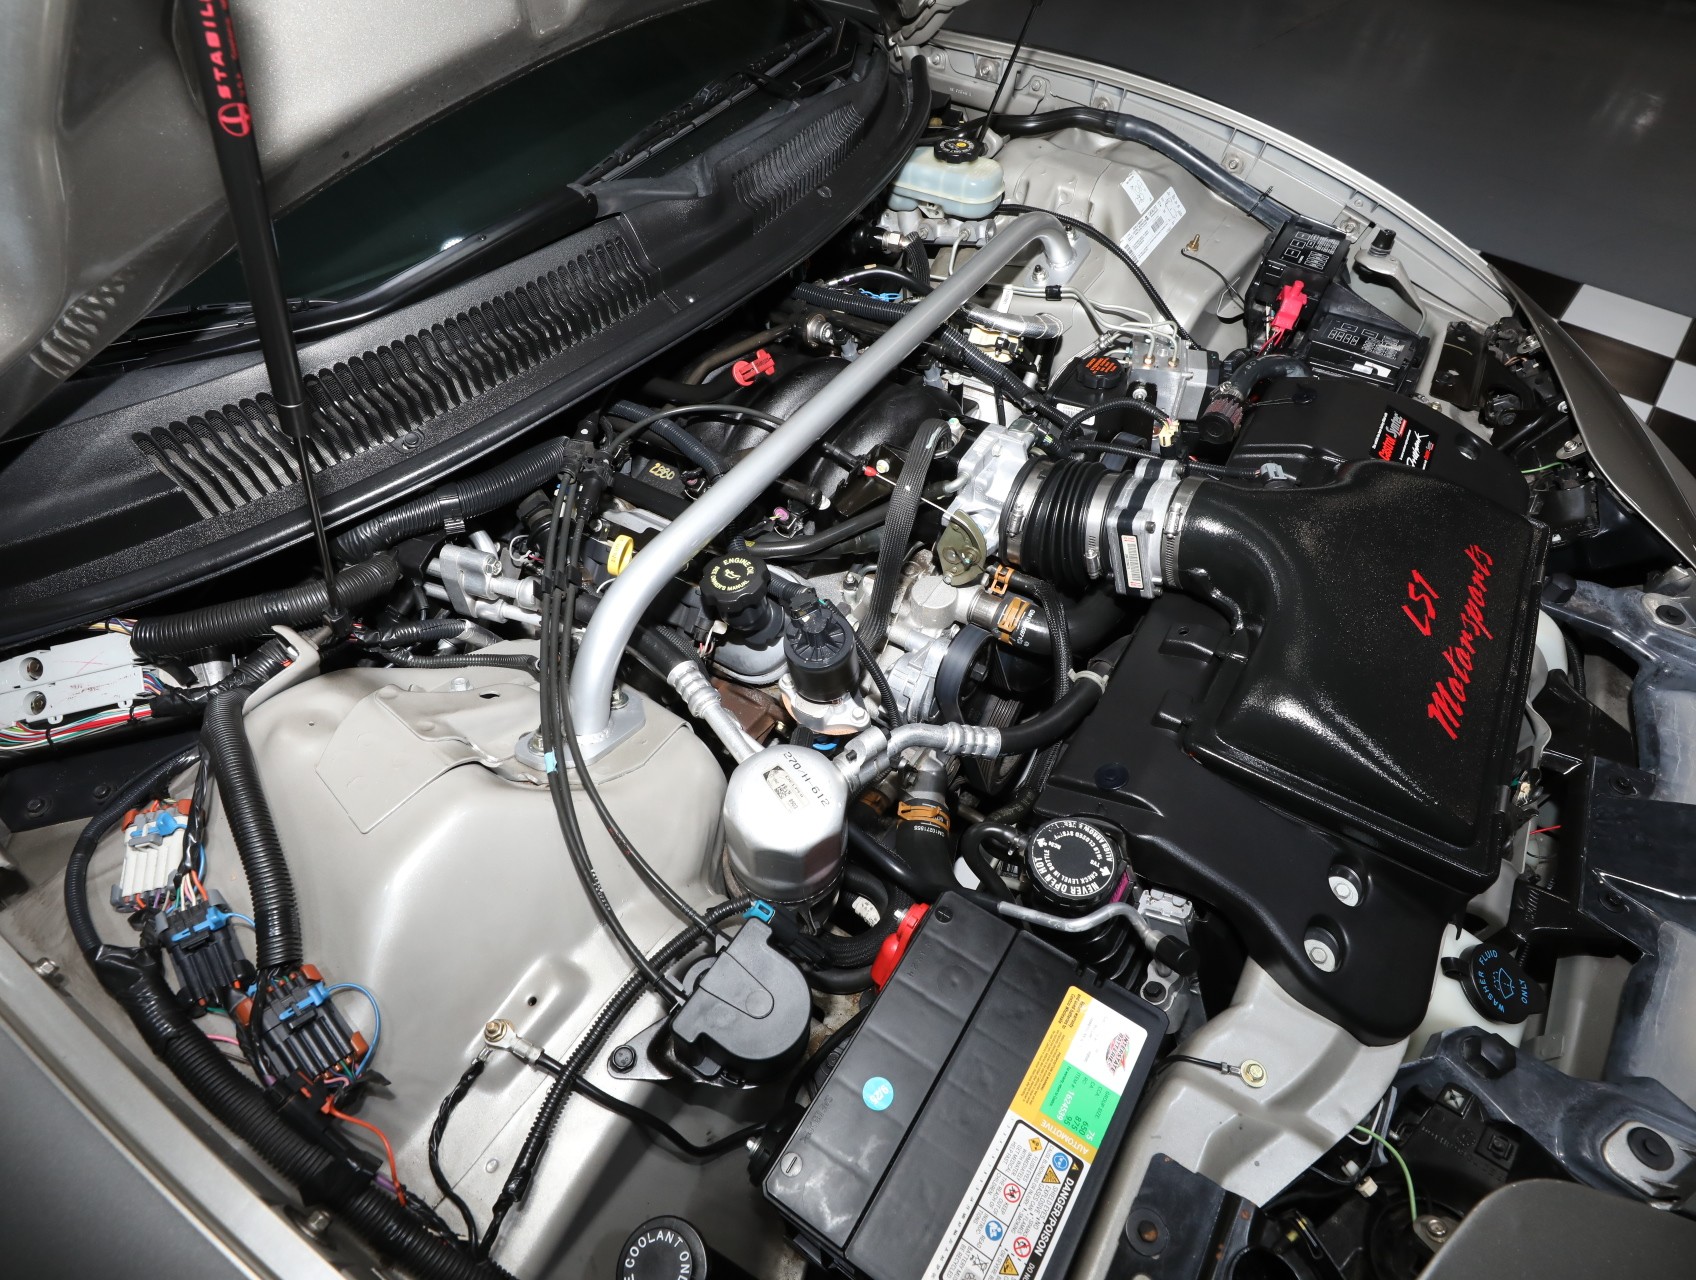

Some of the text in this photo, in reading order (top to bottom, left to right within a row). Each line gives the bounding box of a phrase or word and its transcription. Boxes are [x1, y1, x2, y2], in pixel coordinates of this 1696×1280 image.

[1378, 433, 1396, 462] Castrol
[722, 557, 754, 575] ENGINE OIL
[710, 574, 726, 590] OWNER'S
[726, 579, 749, 590] MANUAL
[1402, 570, 1441, 637] LS1
[1428, 545, 1495, 740] Motorsports
[1075, 831, 1095, 846] CLOSED
[1043, 849, 1054, 870] BOTTLE
[1101, 843, 1112, 861] ALIGN
[1032, 856, 1099, 894] NEVER OPEN HOT
[1061, 874, 1078, 883] LEVEL
[1080, 871, 1098, 884] CHECK
[1479, 949, 1506, 1013] WASHER FLUID
[1520, 978, 1529, 1004] ONLY
[1106, 1032, 1123, 1066] BATTERIES
[1110, 1034, 1130, 1073] INTERSTATE
[1055, 1089, 1075, 1121] 1624539
[1069, 1081, 1095, 1131] CA 875
[1077, 1085, 1102, 1136] CCA 650
[1094, 1107, 1103, 1119] SIZE
[1062, 1114, 1072, 1126] 95
[1040, 1119, 1088, 1155] AUTOMOTIVE
[1084, 1129, 1095, 1141] 75
[1006, 1140, 1016, 1154] HELP
[1017, 1147, 1027, 1161] WITH
[1044, 1144, 1054, 1159] CAUSE
[1004, 1144, 1022, 1174] GET MEDICAL
[1015, 1151, 1032, 1181] IMMEDIATELY
[1022, 1155, 1038, 1182] FLUSH EYES
[1033, 1159, 1047, 1182] BLINDNESS
[987, 1175, 1007, 1208] THE REACH OF
[1027, 1182, 1044, 1211] GASES CAN
[1030, 1181, 1037, 1189] OR
[1045, 1185, 1058, 1204] SHIELD
[991, 1197, 1004, 1215] OUT OF
[999, 1201, 1009, 1215] KEEP
[1033, 1184, 1051, 1214] EXPLOSIVE
[1010, 1211, 1024, 1234] SMOKING
[1016, 1215, 1028, 1235] FLAMES
[1021, 1218, 1034, 1237] SPARKS
[1032, 1219, 1040, 1230] NO
[1033, 1176, 1074, 1256] DANGER/POISON
[625, 1230, 683, 1267] COOLANT
[958, 1244, 966, 1252] BE
[975, 1234, 985, 1249] READ
[957, 1245, 973, 1269] BATTERY
[990, 1249, 1006, 1275] OR SEVERE
[1025, 1262, 1035, 1273] DO
